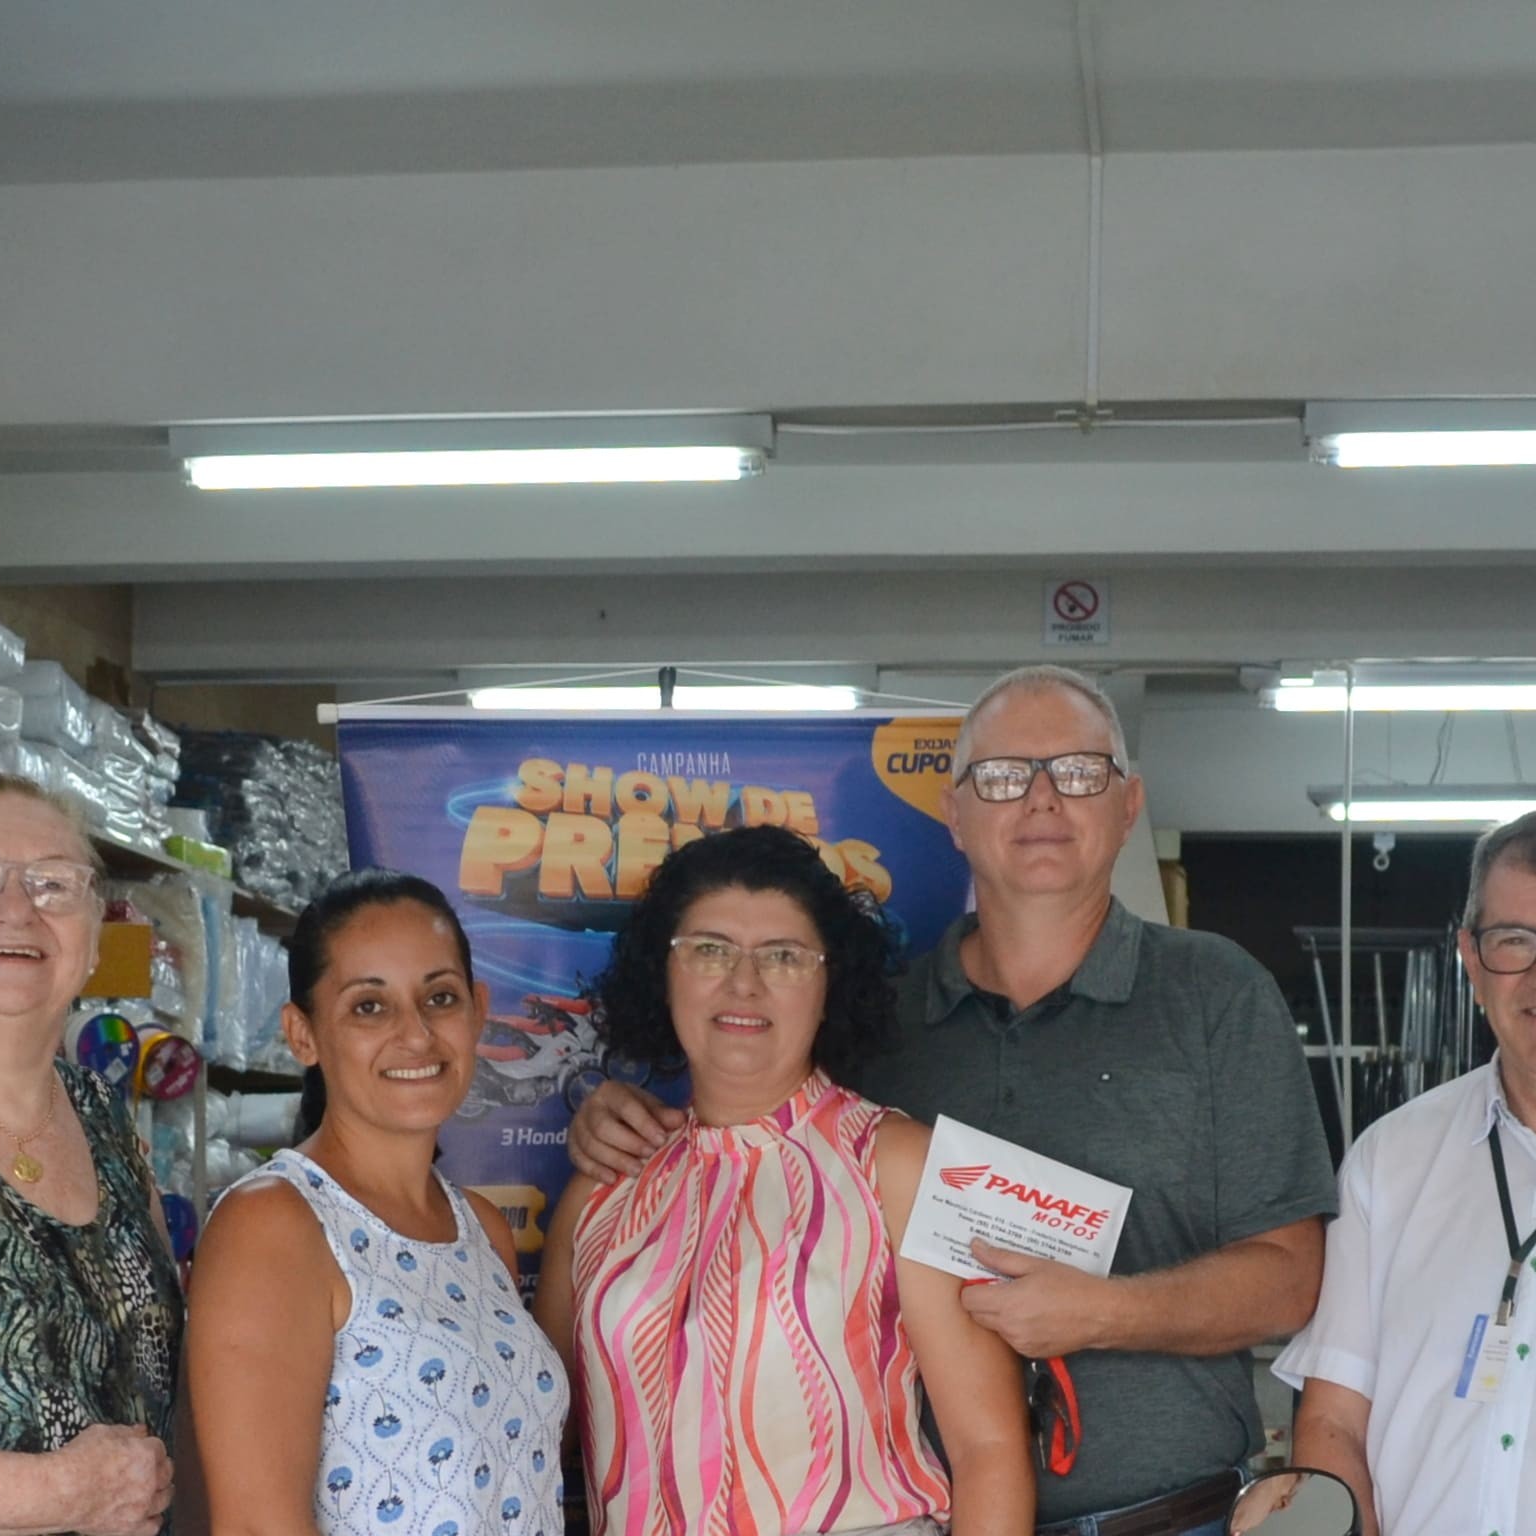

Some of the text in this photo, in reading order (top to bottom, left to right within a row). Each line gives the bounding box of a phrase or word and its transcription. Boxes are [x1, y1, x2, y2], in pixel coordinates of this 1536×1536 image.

[636, 751, 731, 776] CAMPANHA
[886, 752, 952, 774] CUPO
[516, 757, 820, 838] SHOW DE
[500, 1128, 567, 1146] 3 Hond
[984, 1173, 1112, 1230] PANAFÉ
[1031, 1210, 1099, 1242] MOTOS
